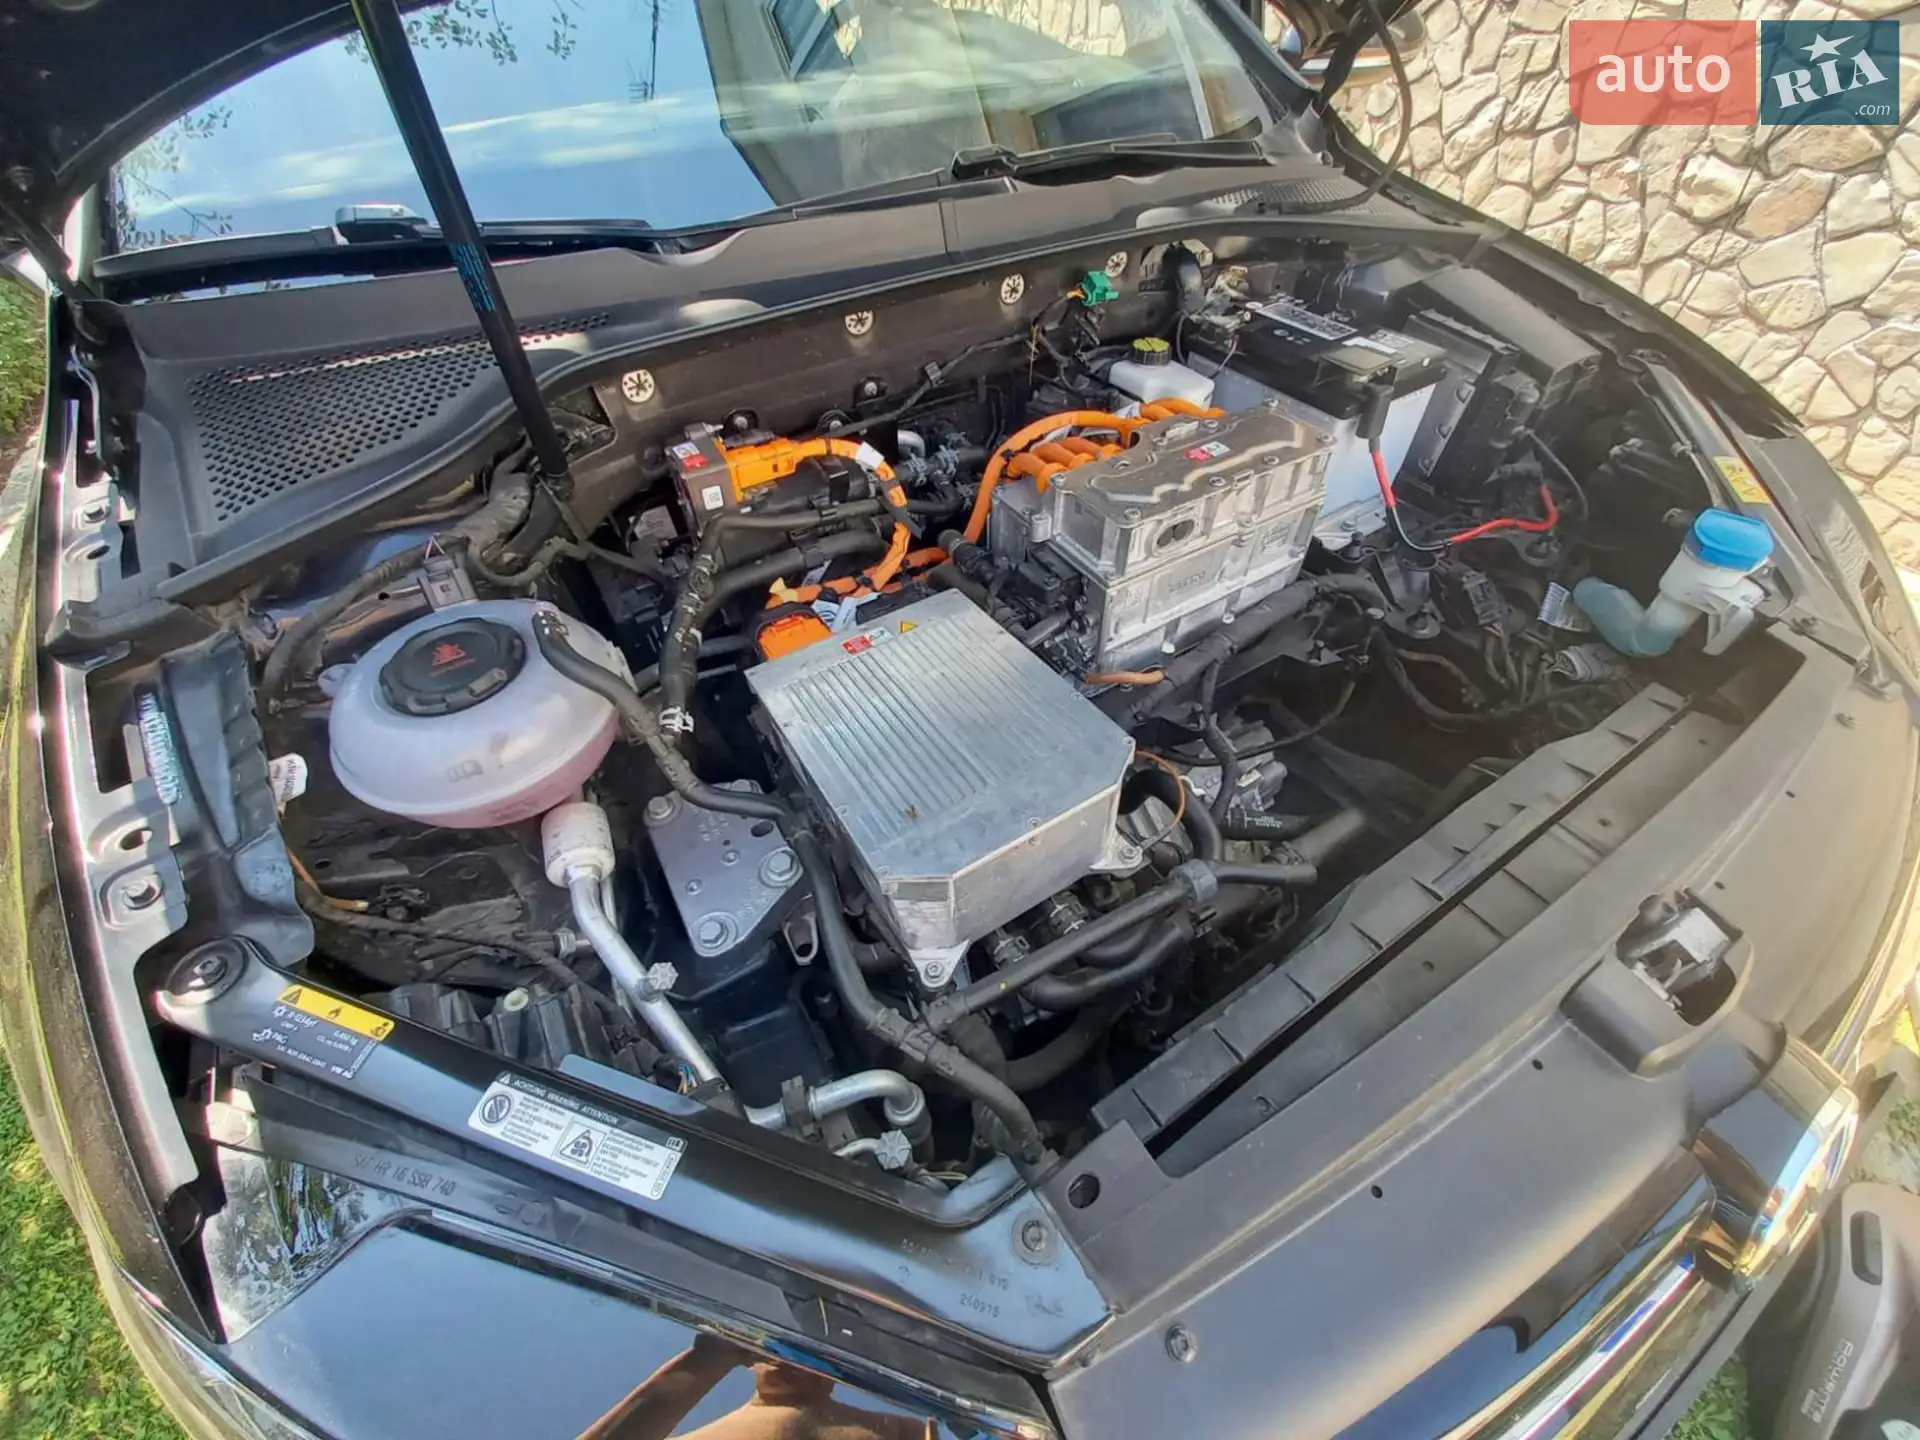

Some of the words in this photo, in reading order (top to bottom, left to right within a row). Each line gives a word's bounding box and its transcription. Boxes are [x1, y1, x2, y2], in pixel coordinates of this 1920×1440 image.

[512, 1078, 547, 1098] ACHTUNG
[548, 1091, 581, 1111] WARNING
[582, 1105, 620, 1125] ATTENTION
